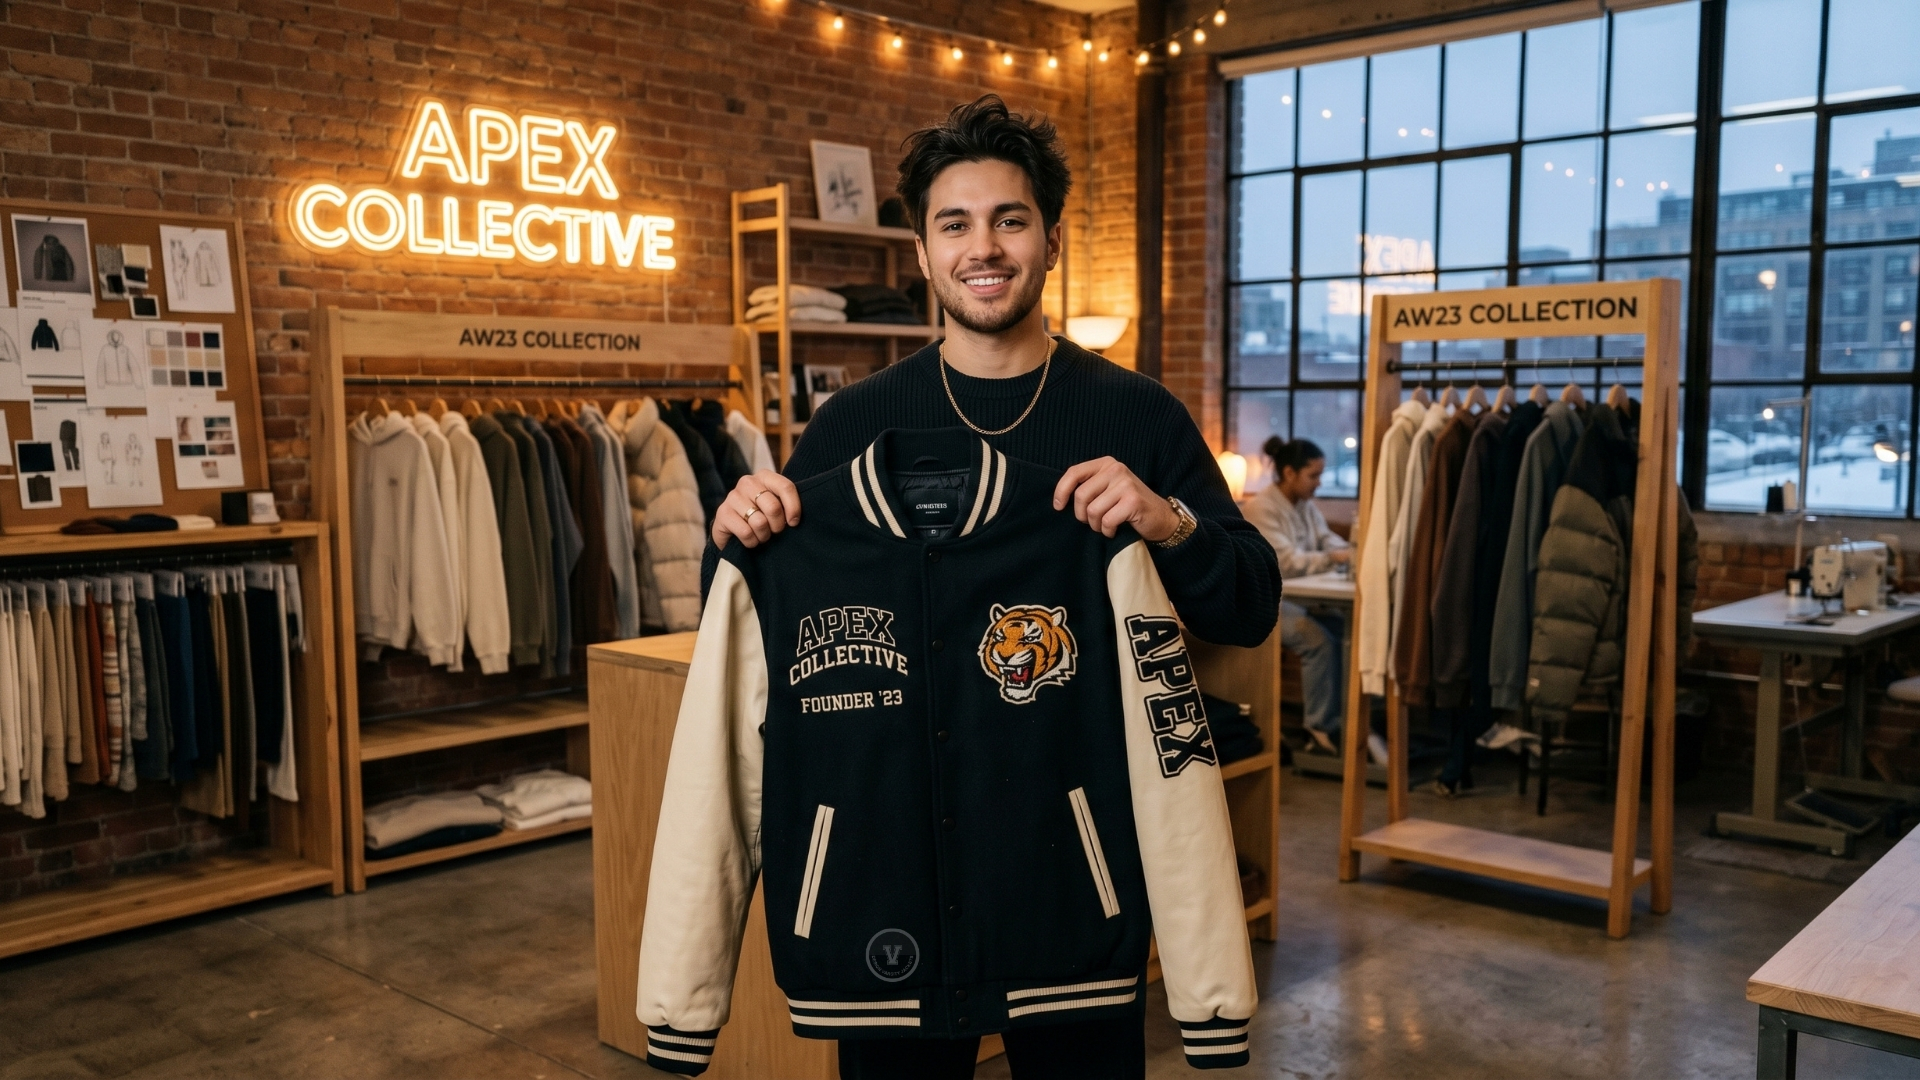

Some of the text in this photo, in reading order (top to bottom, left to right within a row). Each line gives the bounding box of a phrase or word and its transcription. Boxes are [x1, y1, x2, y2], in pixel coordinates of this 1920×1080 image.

[402, 101, 619, 200] APEX
[295, 183, 677, 270] COLLECTIVE
[1394, 296, 1638, 328] AW23 COLLECTION
[459, 328, 640, 351] AW23 COLLECTION
[796, 606, 896, 657] APEX
[789, 644, 908, 686] COLLECTIVE
[801, 689, 903, 713] FOUNDER '23
[1124, 614, 1216, 778] APEX
